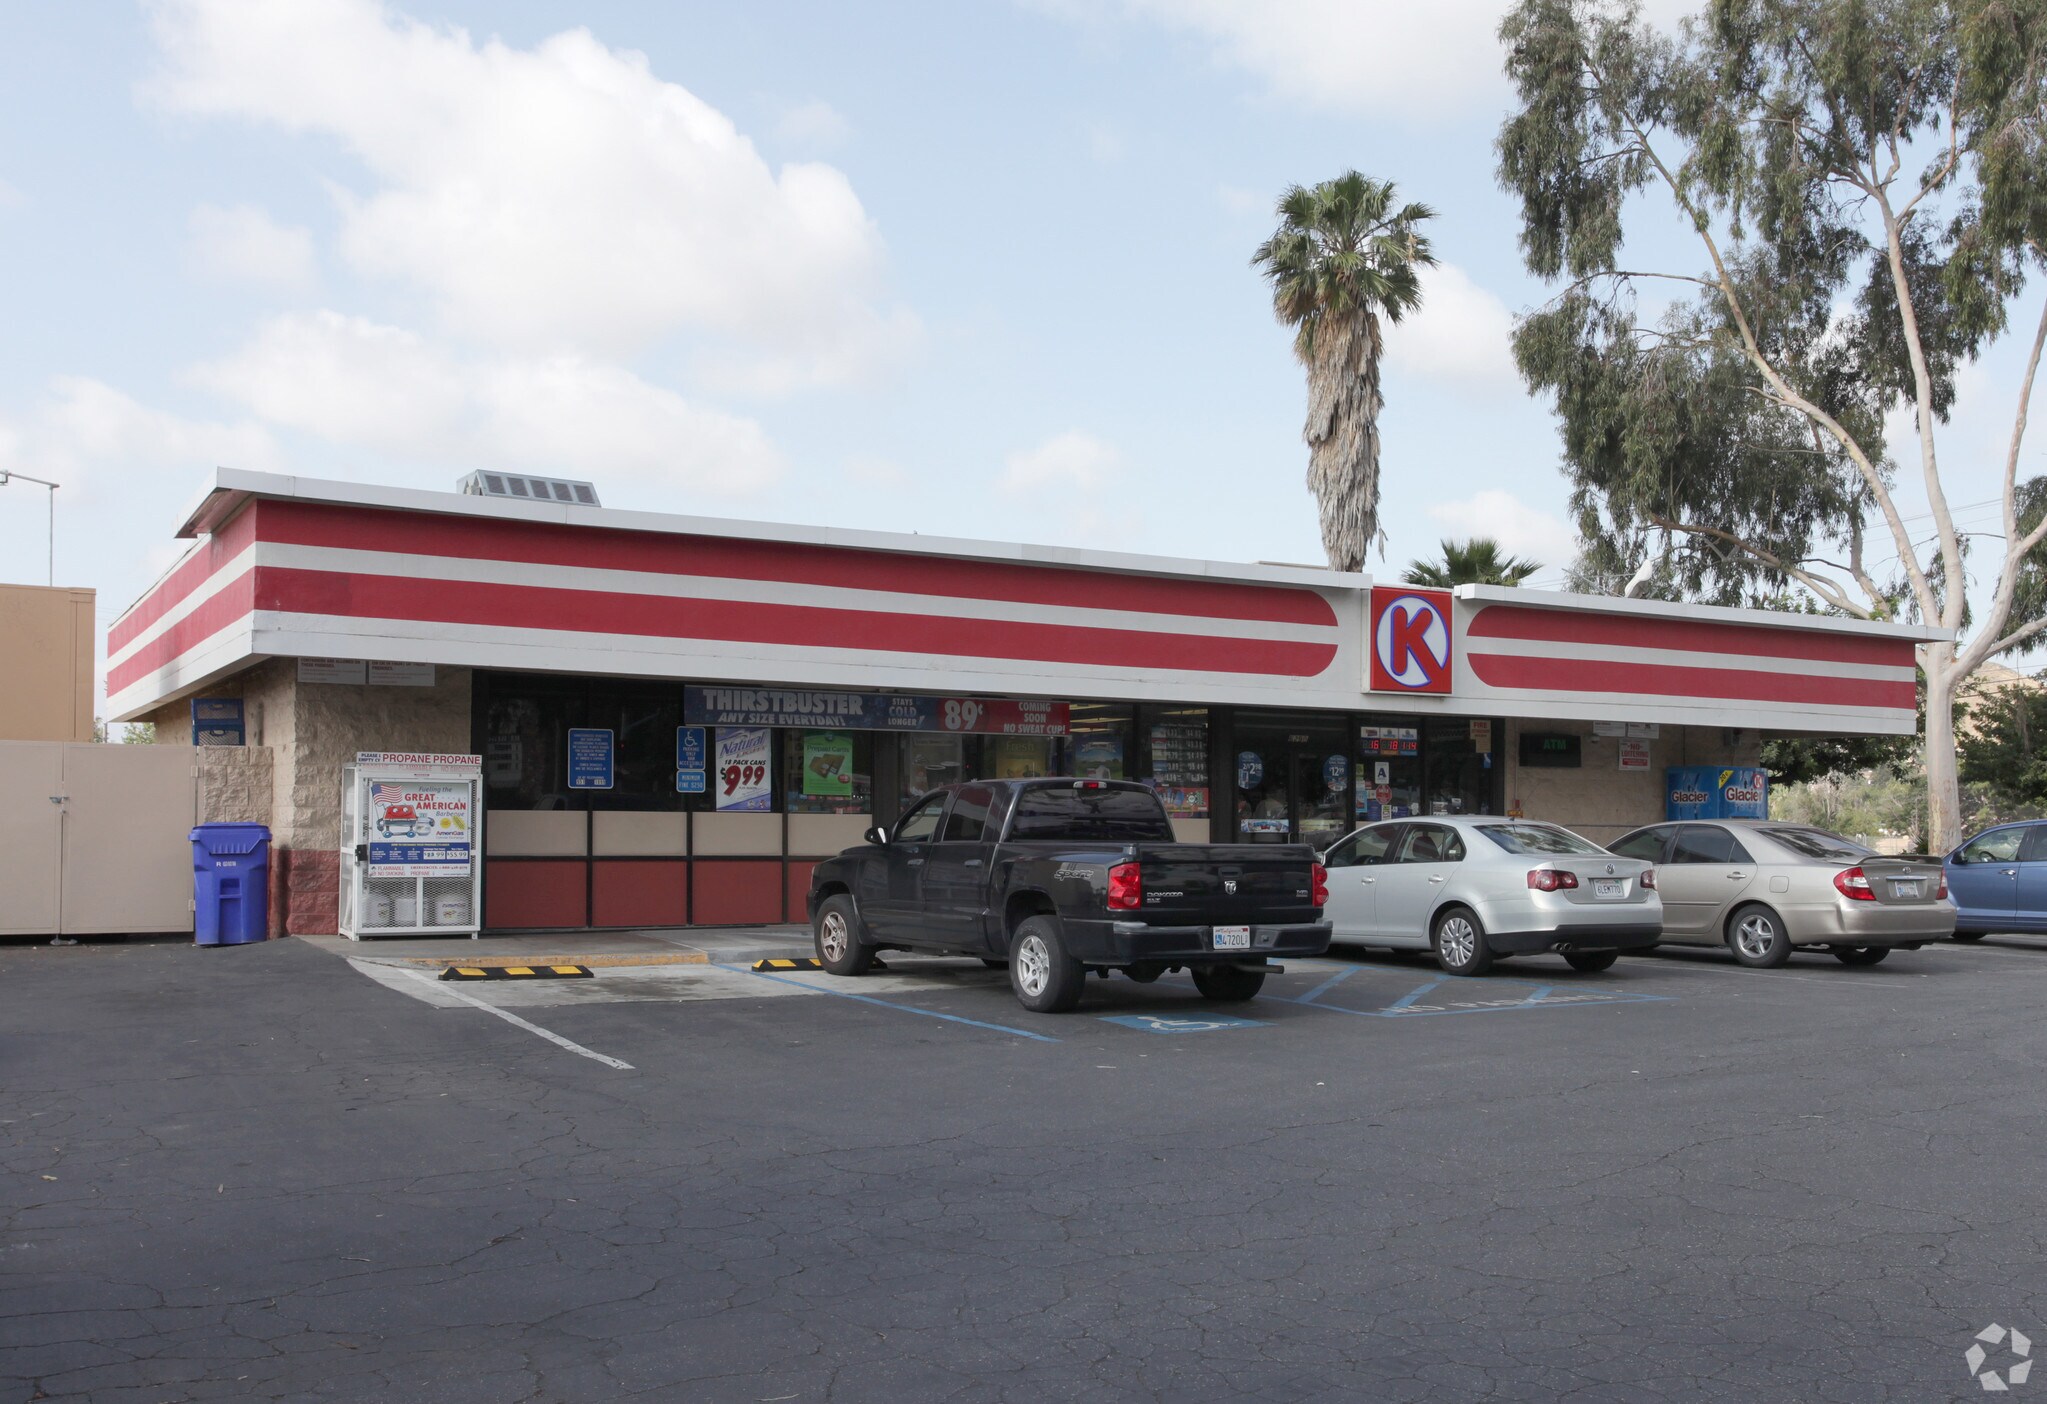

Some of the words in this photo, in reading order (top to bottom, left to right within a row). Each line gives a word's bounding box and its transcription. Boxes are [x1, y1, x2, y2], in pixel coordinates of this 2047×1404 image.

[1390, 605, 1444, 684] K
[703, 689, 863, 715] THIRSTBUSTER
[892, 697, 913, 706] STAYS
[1018, 702, 1051, 712] COMING
[888, 706, 917, 718] COLD
[1023, 713, 1047, 723] SOON
[718, 712, 745, 723] ANY
[748, 713, 775, 724] SIZE
[779, 714, 846, 726] EVERYDAY!
[1004, 725, 1016, 733] NO
[1017, 725, 1045, 735] SWEAT
[1046, 726, 1066, 735] CUP!
[719, 731, 767, 758] Natural
[806, 744, 831, 753] Prepaid
[1544, 738, 1566, 750] ATM
[382, 753, 432, 764] PROPANE
[433, 755, 481, 765] PROPANE
[1378, 767, 1387, 778] A
[404, 793, 436, 802] GREAT
[1671, 791, 1708, 803] Glacier
[1725, 787, 1763, 801] Glacier
[415, 802, 467, 810] AMERICAN
